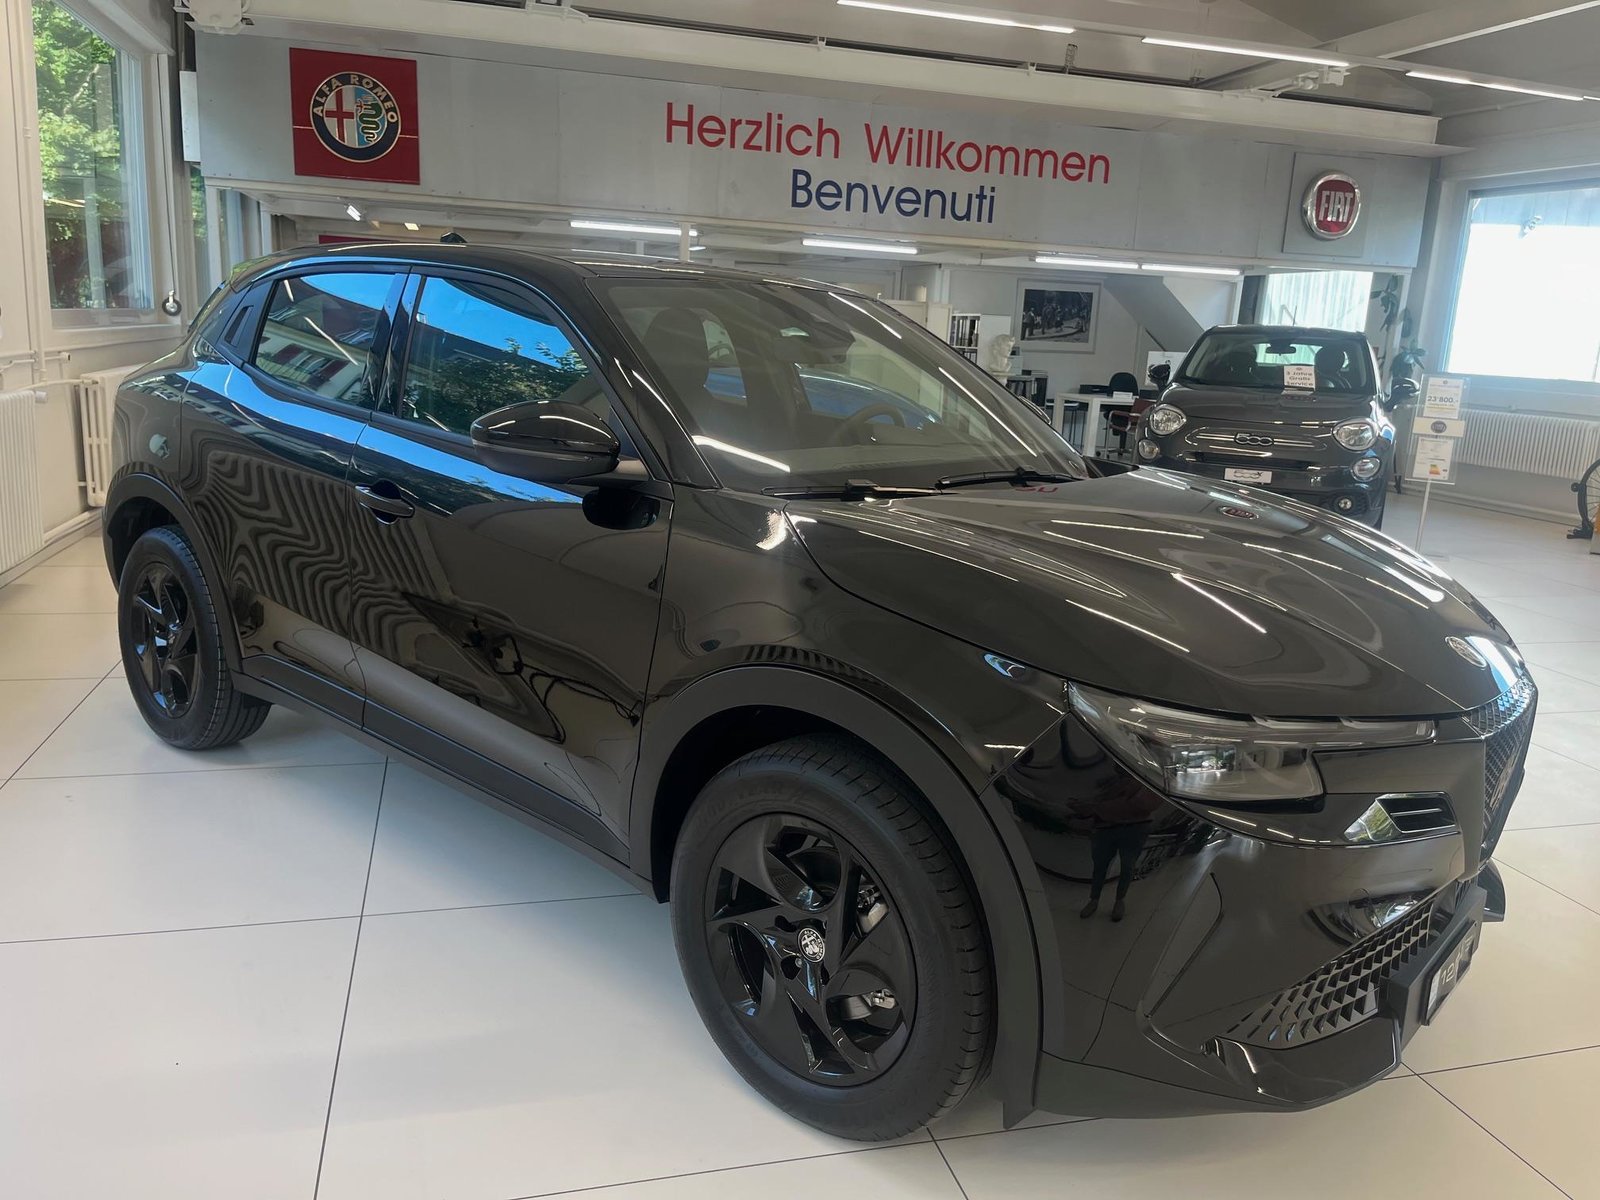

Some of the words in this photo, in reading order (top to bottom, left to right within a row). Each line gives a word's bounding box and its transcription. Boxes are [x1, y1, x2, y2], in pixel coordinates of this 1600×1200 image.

[313, 78, 342, 117] ALFA
[350, 74, 398, 122] ROMEO
[665, 101, 840, 159] Herzlich
[864, 122, 1110, 184] Willkommen
[790, 168, 996, 224] Benvenuti
[1318, 190, 1354, 223] FIAT
[1235, 433, 1273, 446] 500
